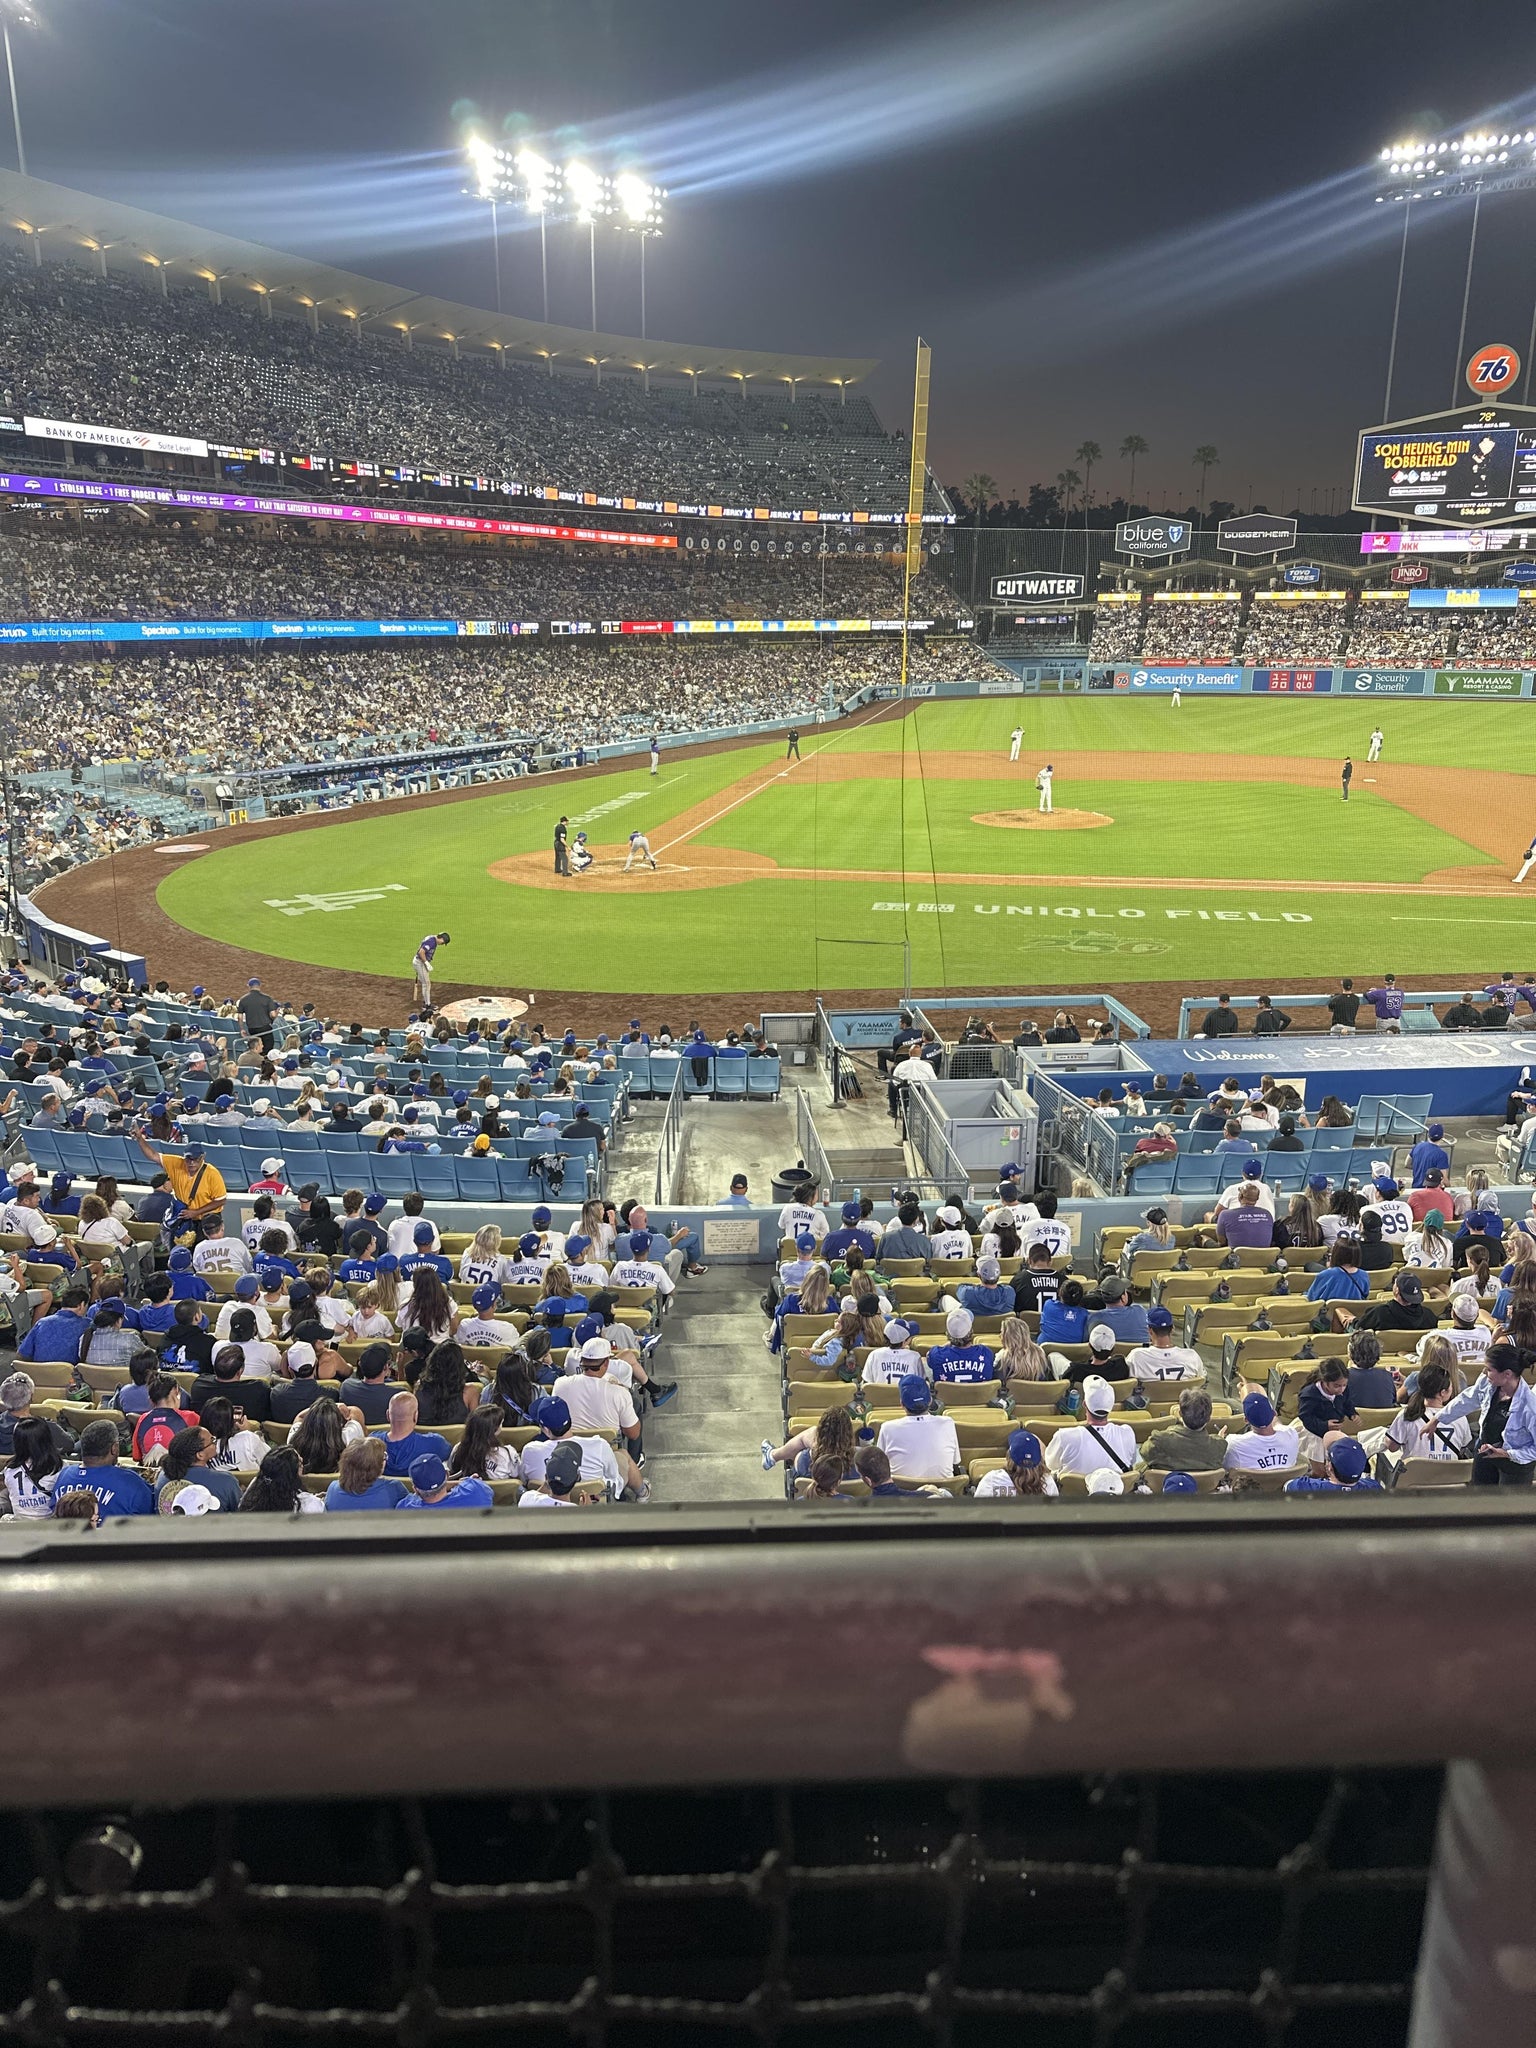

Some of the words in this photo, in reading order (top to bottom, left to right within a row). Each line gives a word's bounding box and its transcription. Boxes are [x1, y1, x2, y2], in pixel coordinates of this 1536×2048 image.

[1475, 356, 1510, 383] 76
[46, 427, 72, 438] BANK
[75, 431, 87, 440] OF
[90, 433, 132, 445] AMERICA
[158, 442, 174, 450] Suite
[176, 444, 192, 452] Level
[1374, 444, 1400, 457] SON
[1402, 440, 1470, 455] HEUNG-MIN
[1384, 454, 1457, 469] BOBBLEHEAD
[60, 484, 84, 494] STOLEN
[86, 485, 103, 496] BASE
[114, 488, 130, 498] FREE
[559, 492, 576, 500] JERKY
[254, 500, 259, 508] A
[260, 501, 273, 510] PLAY
[274, 502, 286, 512] THAT
[598, 497, 614, 506] JERKY
[636, 502, 654, 510] JERKY
[678, 506, 698, 514] JERKY
[723, 508, 744, 516] JERKY
[770, 511, 792, 519] JERKY
[1123, 525, 1163, 542] blue
[1398, 568, 1422, 578] JINRO
[997, 580, 1076, 596] CUTWATER
[60, 628, 72, 638] big
[141, 626, 178, 637] Spectrum
[206, 627, 216, 635] big
[272, 624, 301, 634] Spectrum
[1150, 673, 1194, 687] Security
[1196, 672, 1236, 684] Benefit
[1375, 673, 1410, 685] Security
[1375, 683, 1404, 692] Benefit
[974, 904, 1146, 918] UNIQLO
[1165, 909, 1312, 922] FIELD
[1386, 997, 1402, 1010] 53
[1183, 1048, 1280, 1062] Welcome
[1303, 1044, 1402, 1058] ようこそ
[1380, 1204, 1400, 1212] KELLY
[792, 1210, 814, 1220] OHTANI
[1382, 1213, 1409, 1234] 99
[794, 1222, 810, 1239] 17
[1035, 1226, 1067, 1236] 大谷翔平
[943, 1240, 964, 1251] OHTANI
[202, 1248, 230, 1260] EDMAN
[350, 1270, 371, 1280] BETTS
[468, 1267, 492, 1284] 50
[511, 1266, 543, 1278] ROBINSON
[621, 1270, 656, 1282] PEDERSON
[1032, 1277, 1059, 1288] OHTANI
[1036, 1292, 1058, 1312] 17
[466, 1330, 484, 1340] WORLD
[485, 1331, 503, 1342] SERIES
[882, 1362, 910, 1374] OHTANI
[942, 1360, 985, 1373] FREEMAN
[1155, 1367, 1185, 1380] 17
[154, 1428, 162, 1442] LA
[1428, 1428, 1454, 1452] 17
[1258, 1454, 1288, 1468] BETTS
[19, 1496, 48, 1508] OHTANI
